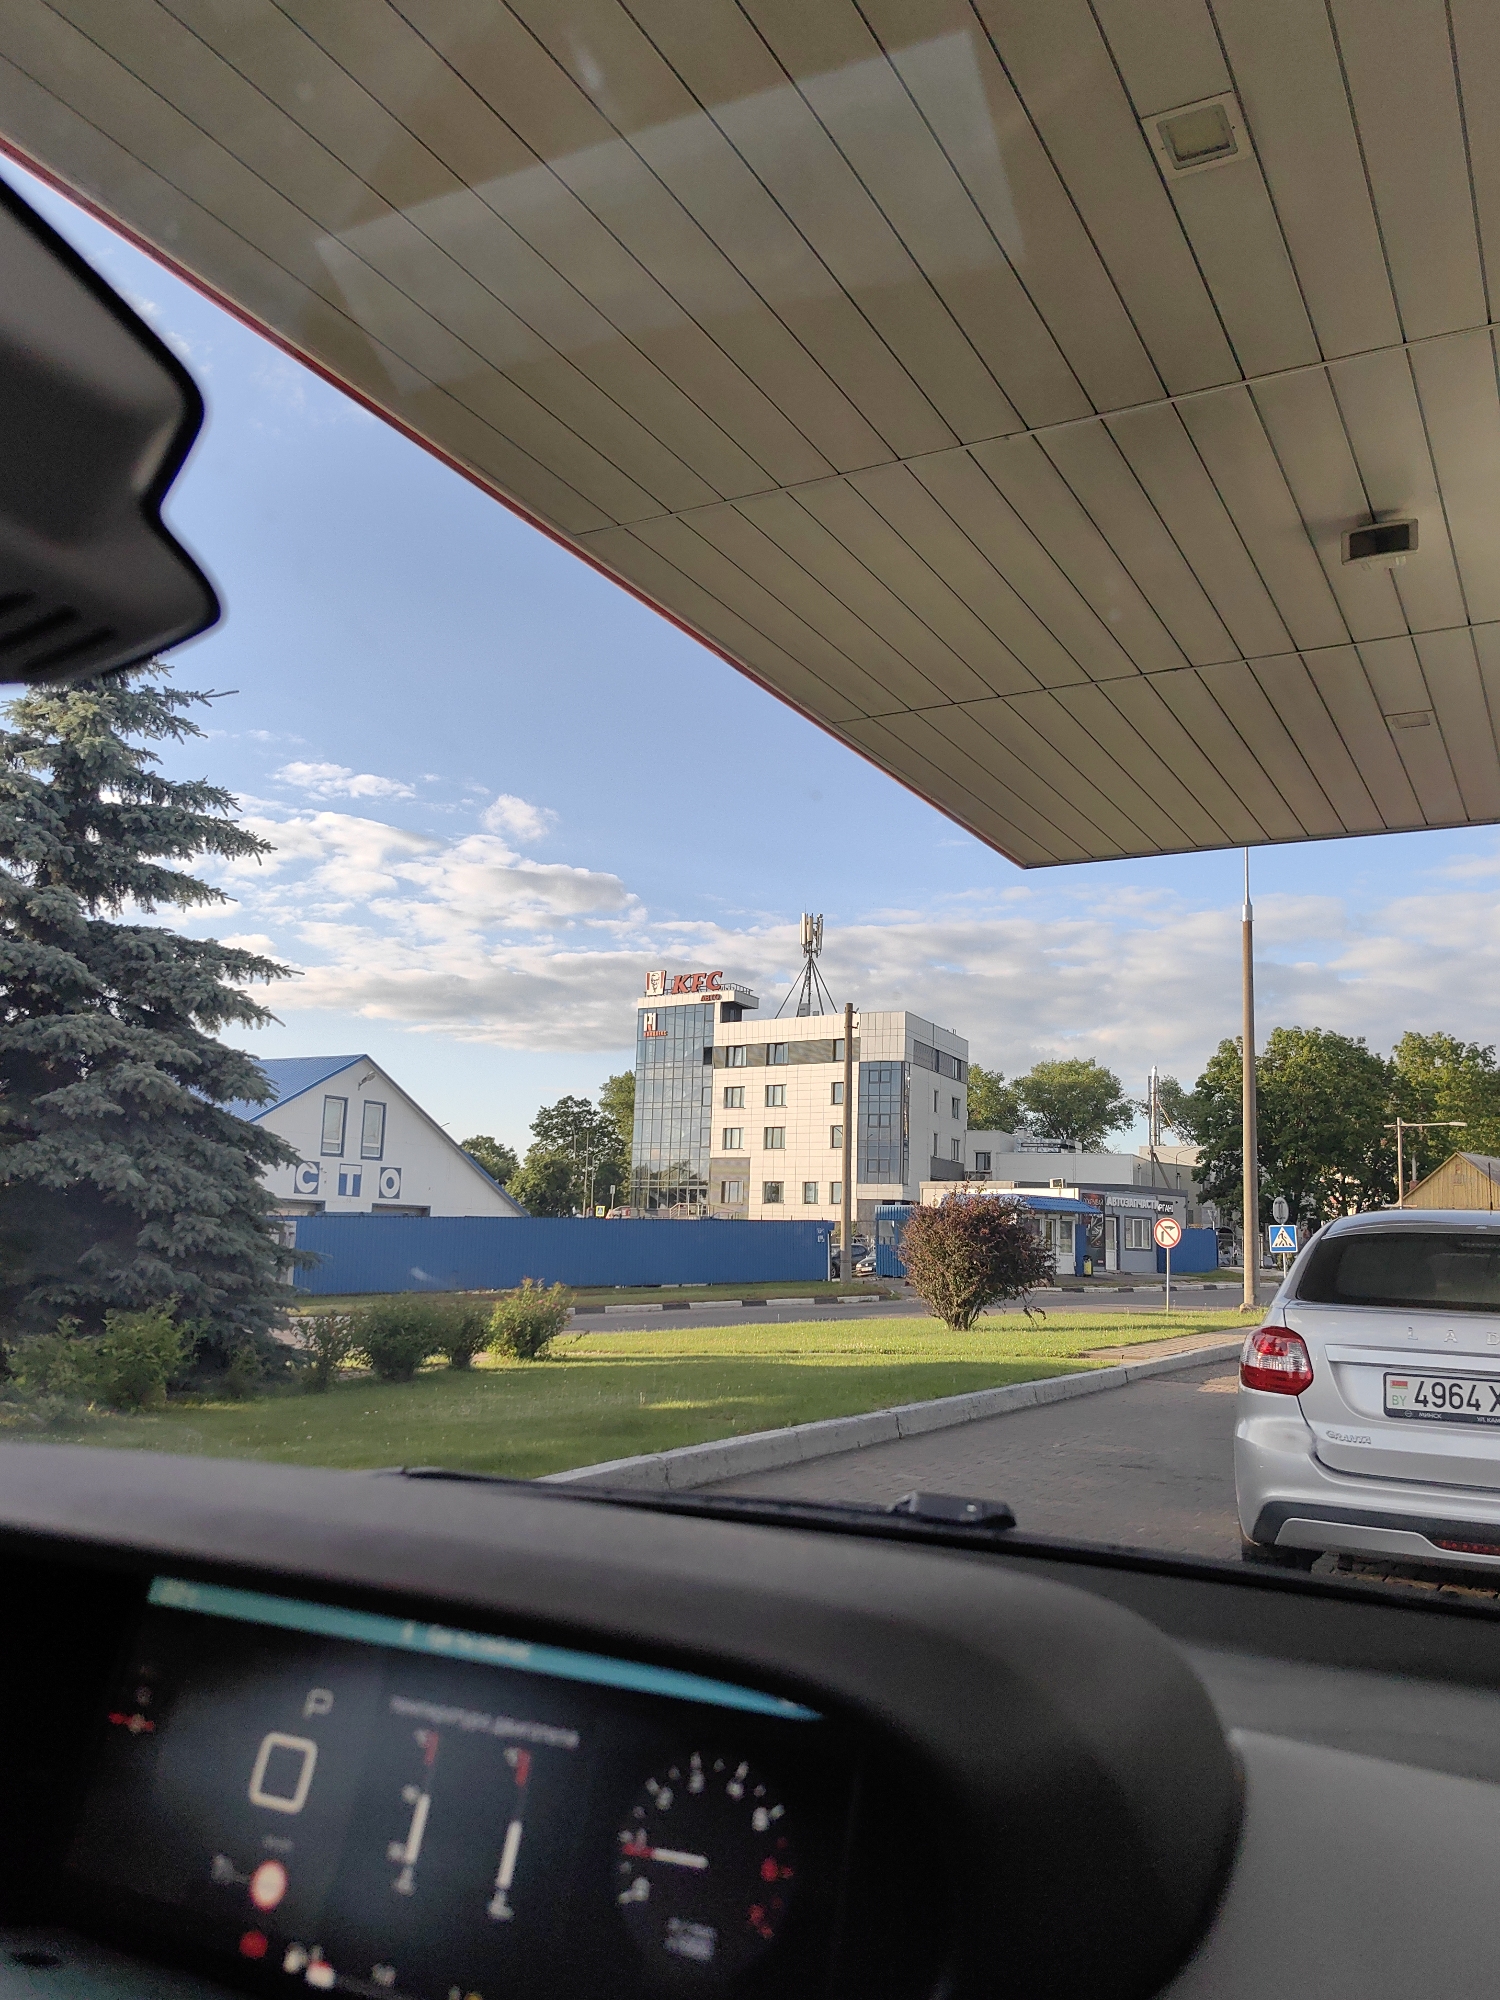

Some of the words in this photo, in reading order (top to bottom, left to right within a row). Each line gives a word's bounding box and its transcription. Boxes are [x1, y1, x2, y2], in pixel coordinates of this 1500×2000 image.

[671, 970, 723, 994] KFC
[295, 1161, 400, 1198] СТО
[1391, 1394, 1407, 1406] BY
[1414, 1381, 1481, 1412] 4964
[1325, 1430, 1372, 1444] GRANTA
[301, 1687, 335, 1721] P
